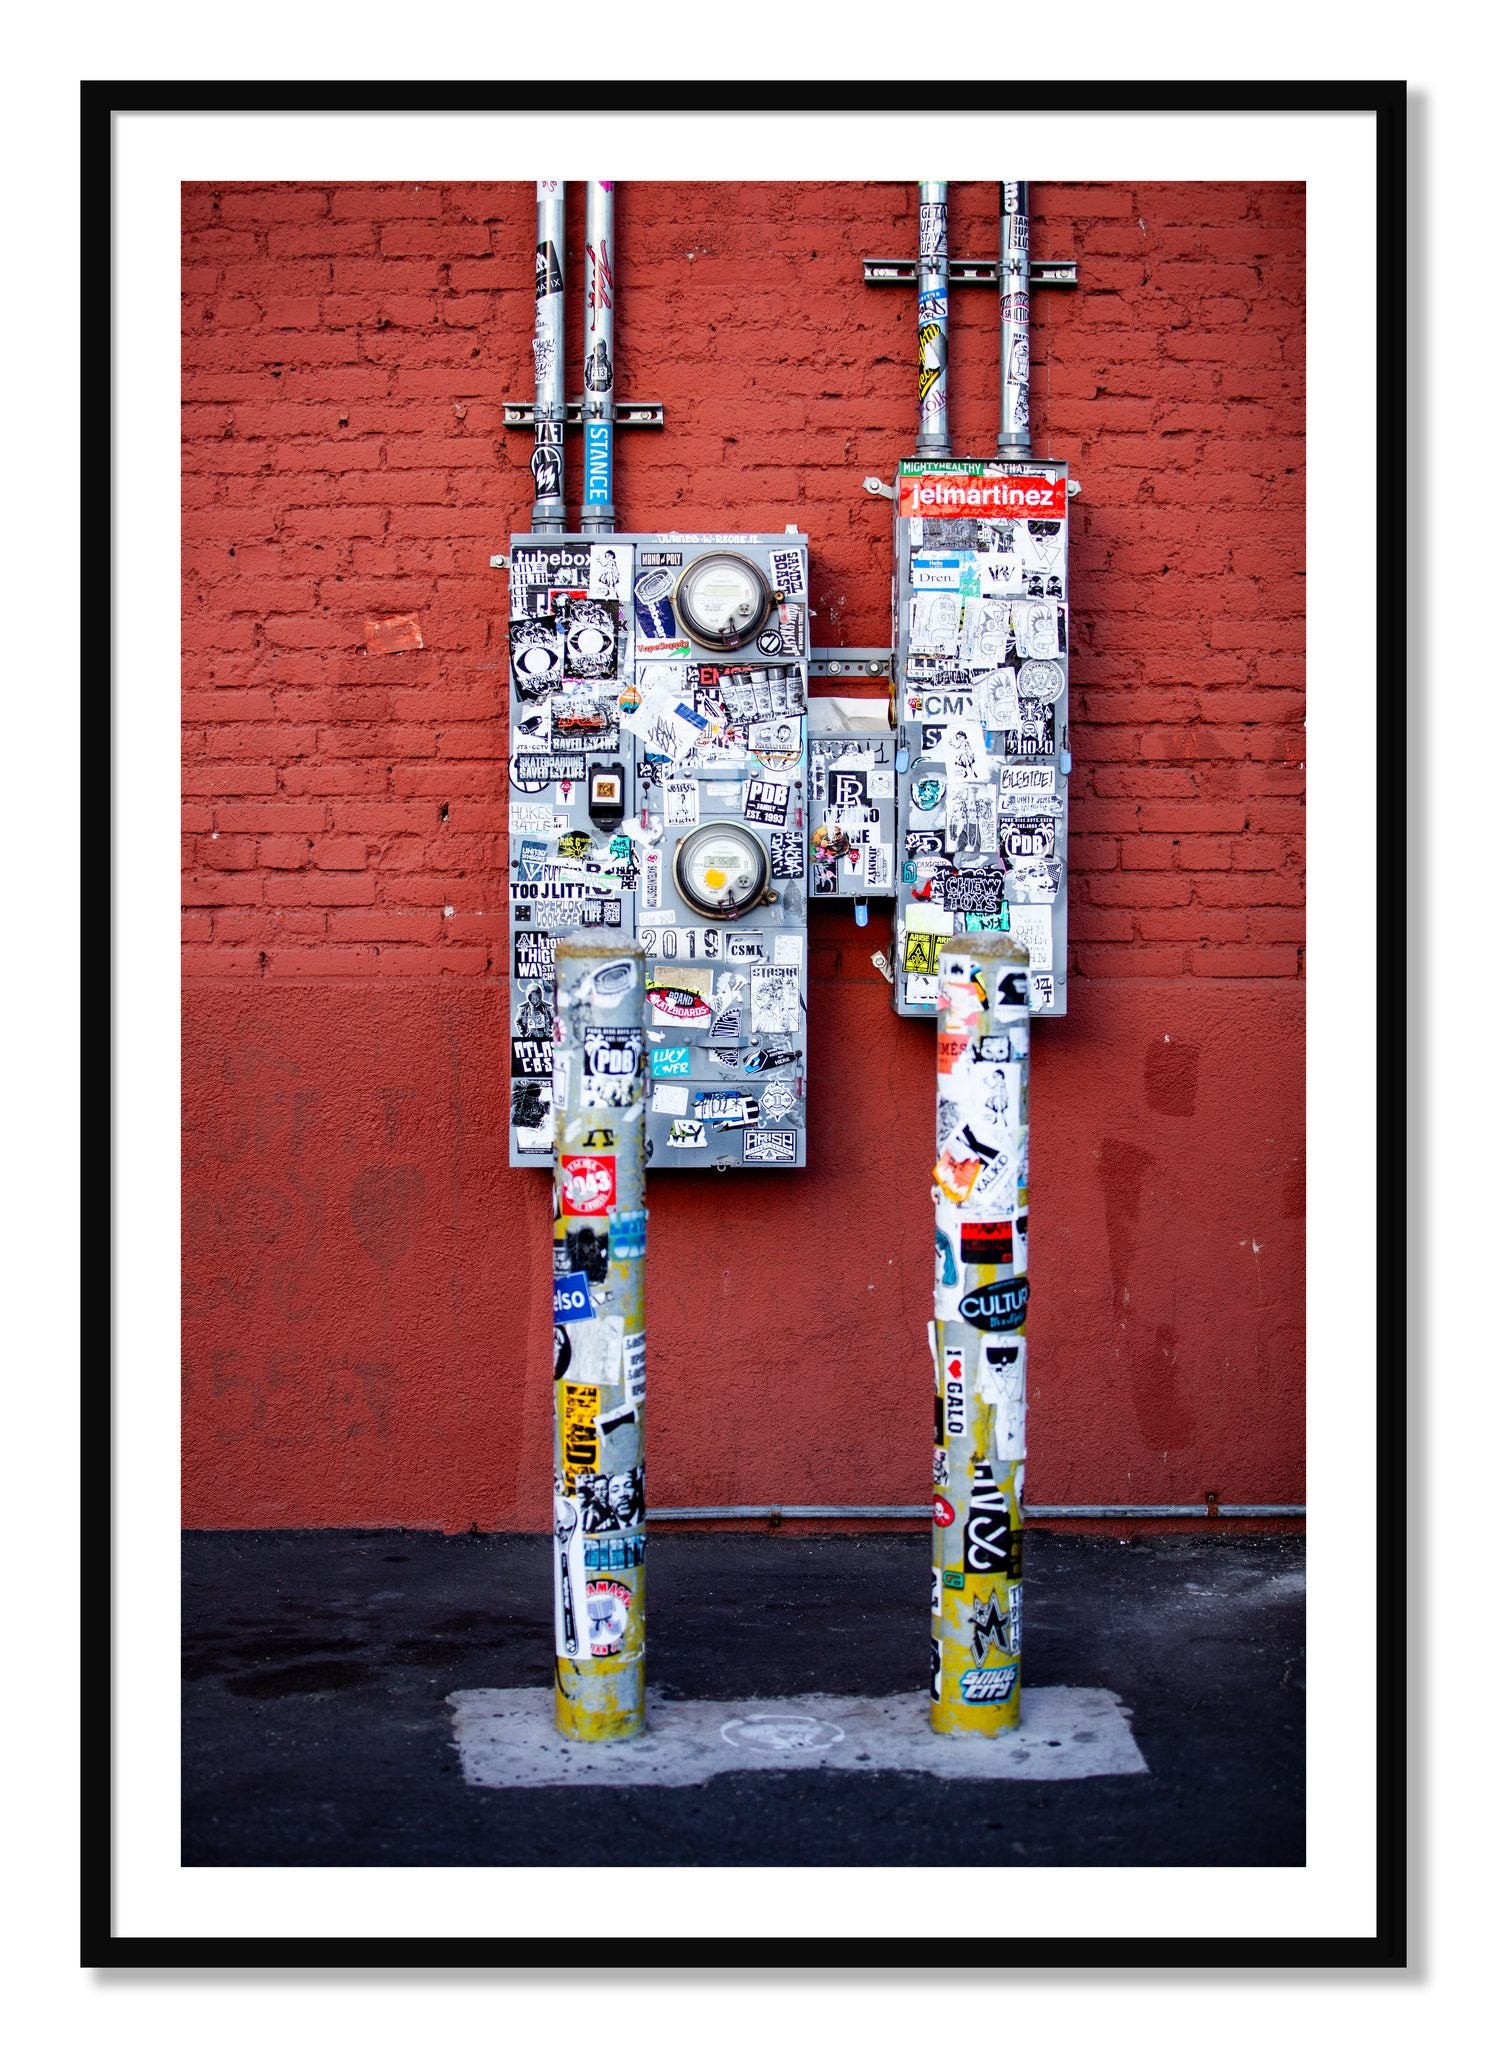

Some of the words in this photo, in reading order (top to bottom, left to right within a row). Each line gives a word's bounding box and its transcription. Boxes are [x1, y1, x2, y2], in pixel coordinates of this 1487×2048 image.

[590, 427, 608, 500] STANCE
[903, 462, 981, 474] MIGHTYHEALTHY
[912, 484, 1054, 509] jelmartinez
[516, 549, 591, 566] tubebox
[750, 781, 788, 806] PDB
[764, 813, 784, 824] 1993
[1011, 834, 1043, 854] PDB
[510, 883, 539, 899] TOO
[945, 877, 1002, 895] CHEW
[947, 894, 997, 911] TOYS
[641, 928, 719, 960] 2019
[909, 933, 931, 942] ARISE
[731, 944, 764, 957] CSMK
[597, 1049, 634, 1073] PDB
[653, 1048, 687, 1063] LUCY
[947, 1382, 964, 1434] GALO
[964, 1682, 1010, 1699] CITY
